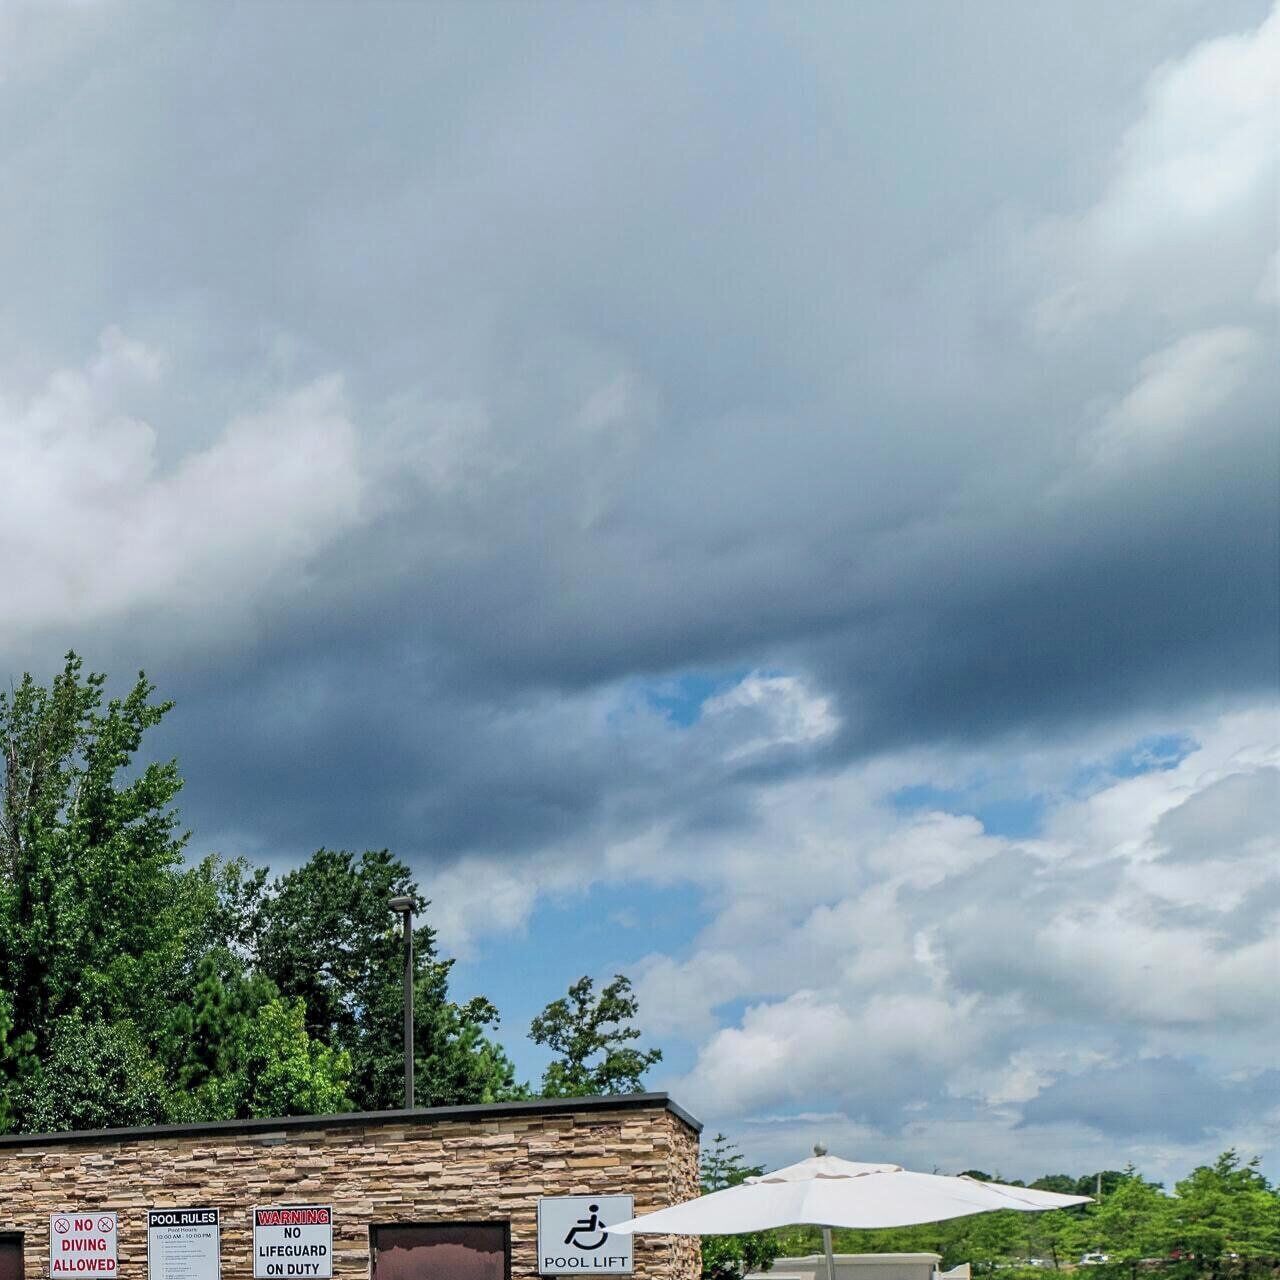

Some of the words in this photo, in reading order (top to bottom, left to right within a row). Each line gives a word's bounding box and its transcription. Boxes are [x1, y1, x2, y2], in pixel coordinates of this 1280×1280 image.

[151, 1214, 180, 1225] POOL
[181, 1212, 216, 1224] RULES
[258, 1210, 329, 1225] WARNING
[75, 1219, 93, 1231] NO
[284, 1227, 301, 1238] NO
[62, 1239, 107, 1251] DIVING
[260, 1245, 327, 1257] LIFEGUARD
[53, 1258, 116, 1271] ALLOWED
[545, 1257, 590, 1267] POOL
[594, 1256, 629, 1267] LIFT
[266, 1264, 283, 1275] ON
[288, 1264, 320, 1275] DUTY
